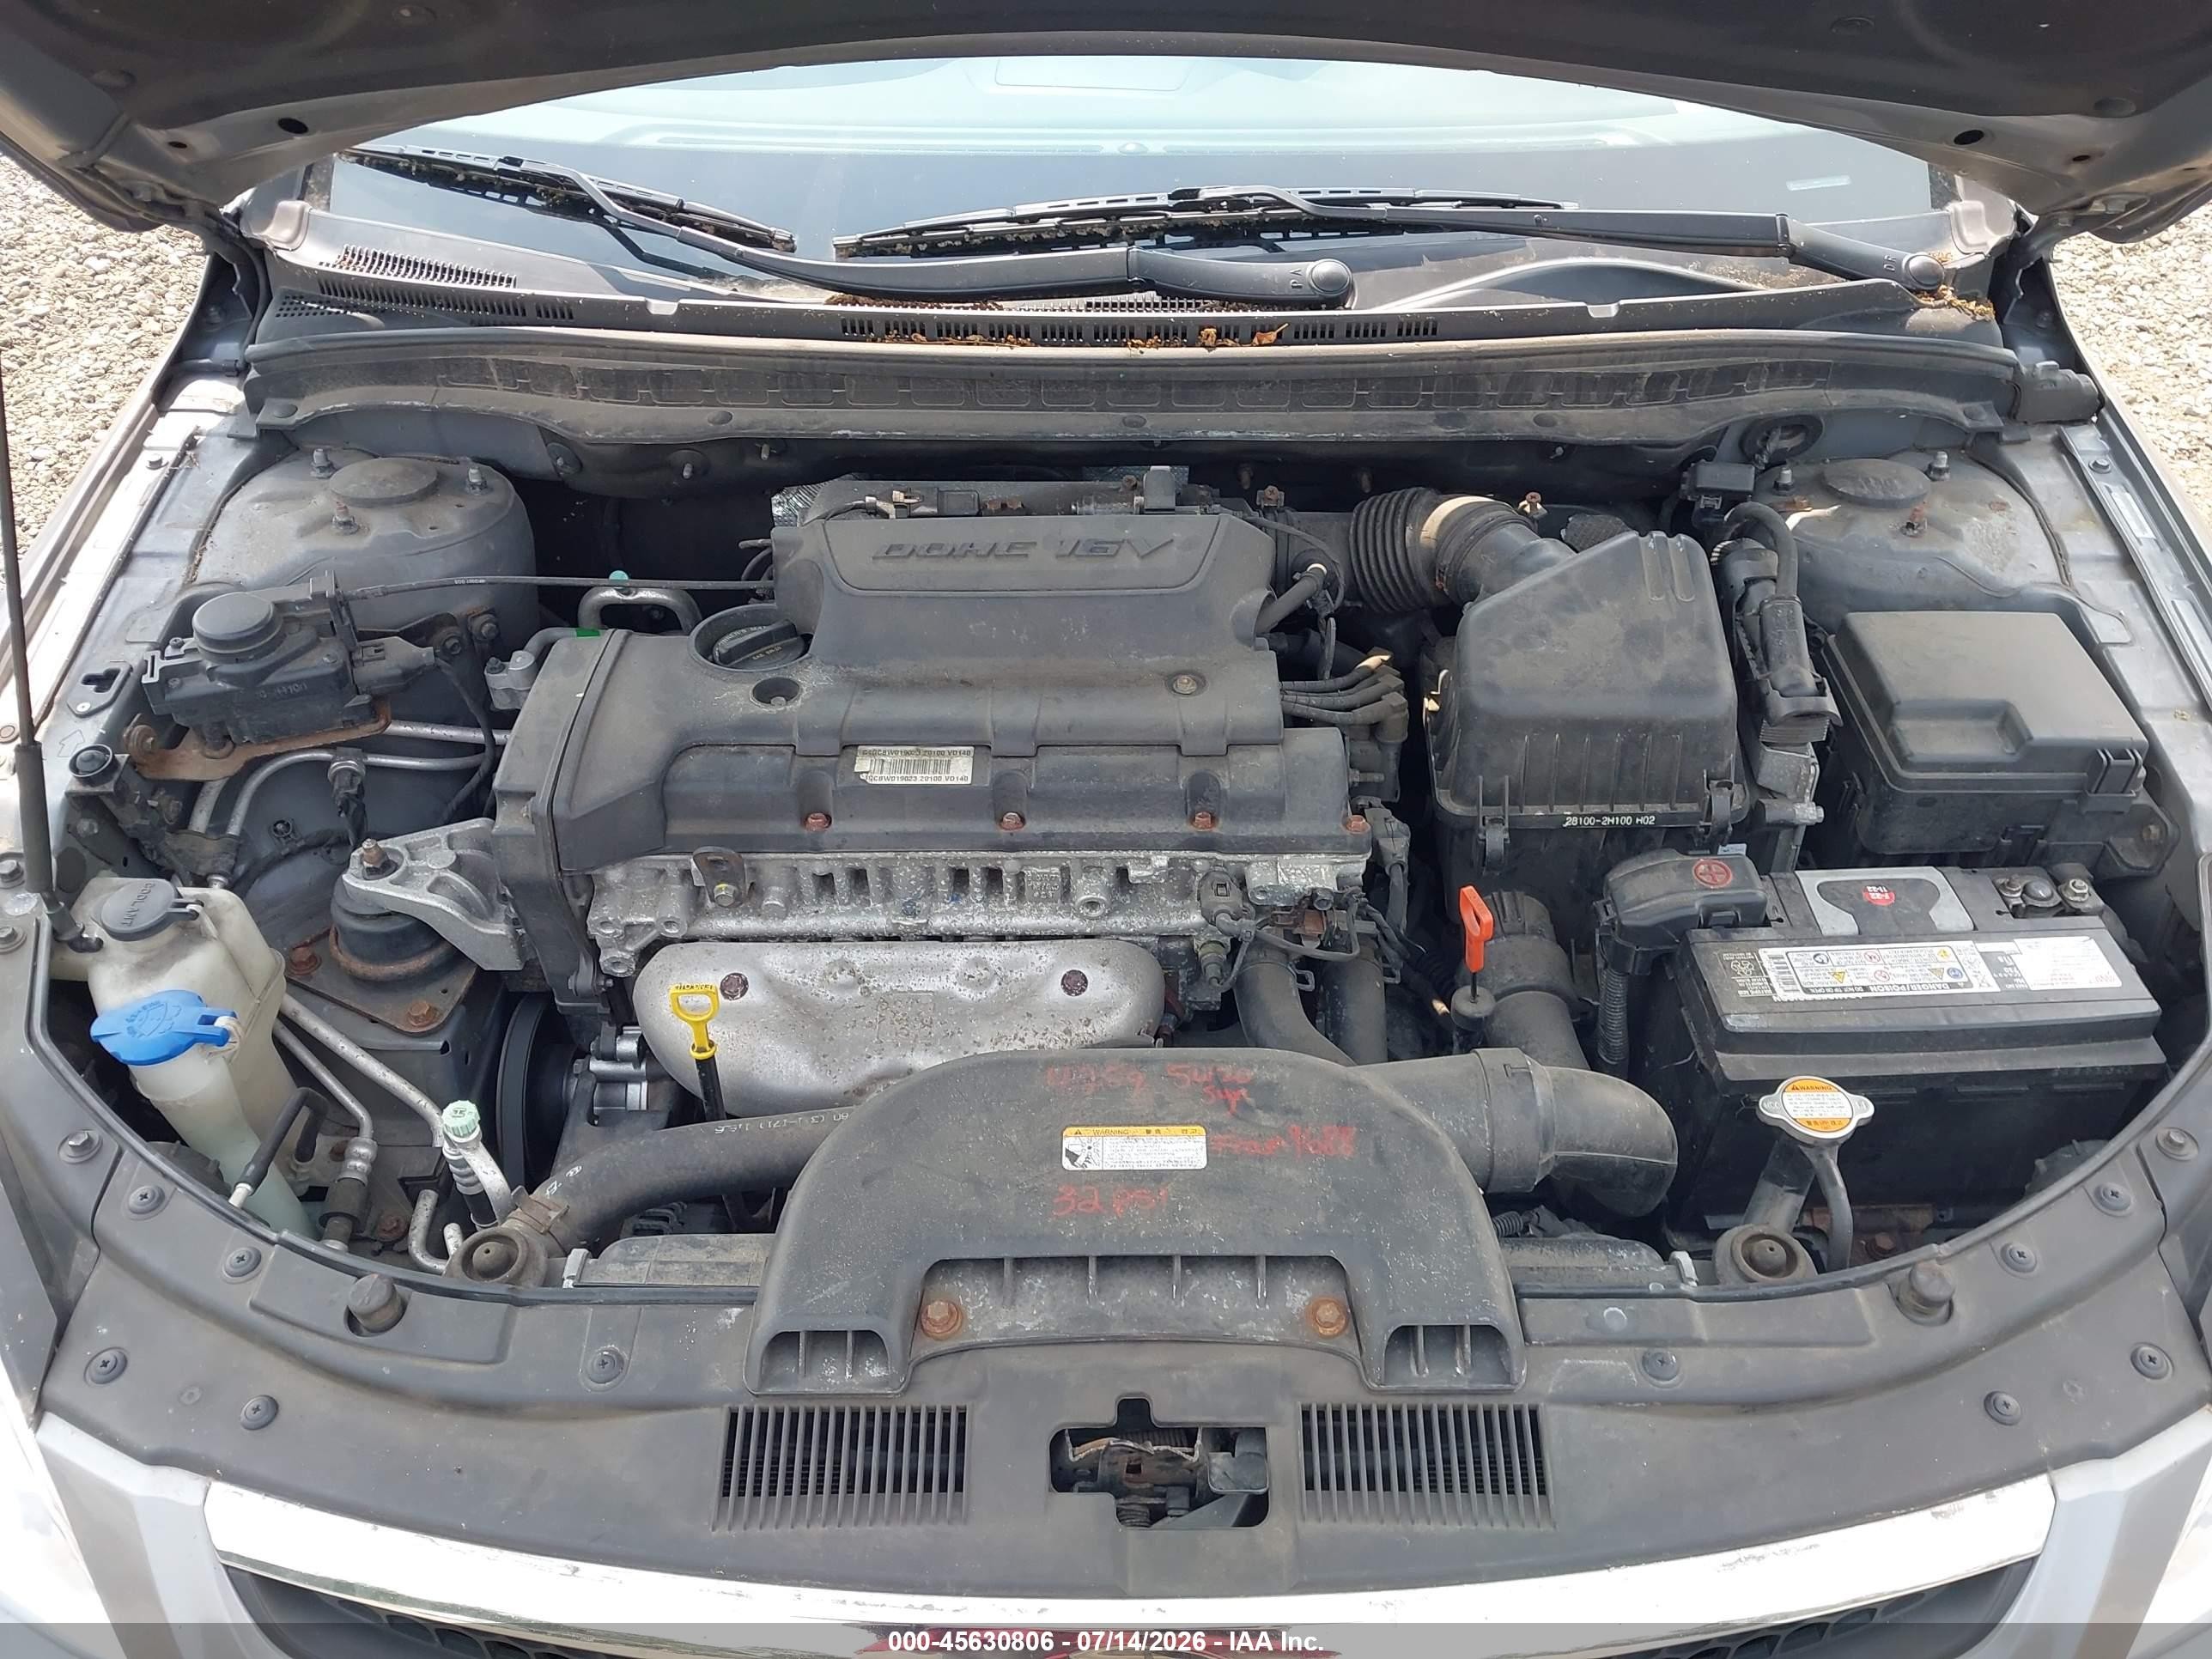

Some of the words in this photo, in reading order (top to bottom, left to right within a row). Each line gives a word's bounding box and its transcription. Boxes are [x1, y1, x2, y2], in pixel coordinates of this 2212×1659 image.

[872, 541, 1036, 561] DOHC
[1055, 538, 1174, 560] 16V
[1565, 816, 1632, 826] 28100-2H100
[1635, 816, 1656, 825] H02
[120, 883, 155, 927] COOLANT
[1869, 982, 1951, 994] DANGER/POISON
